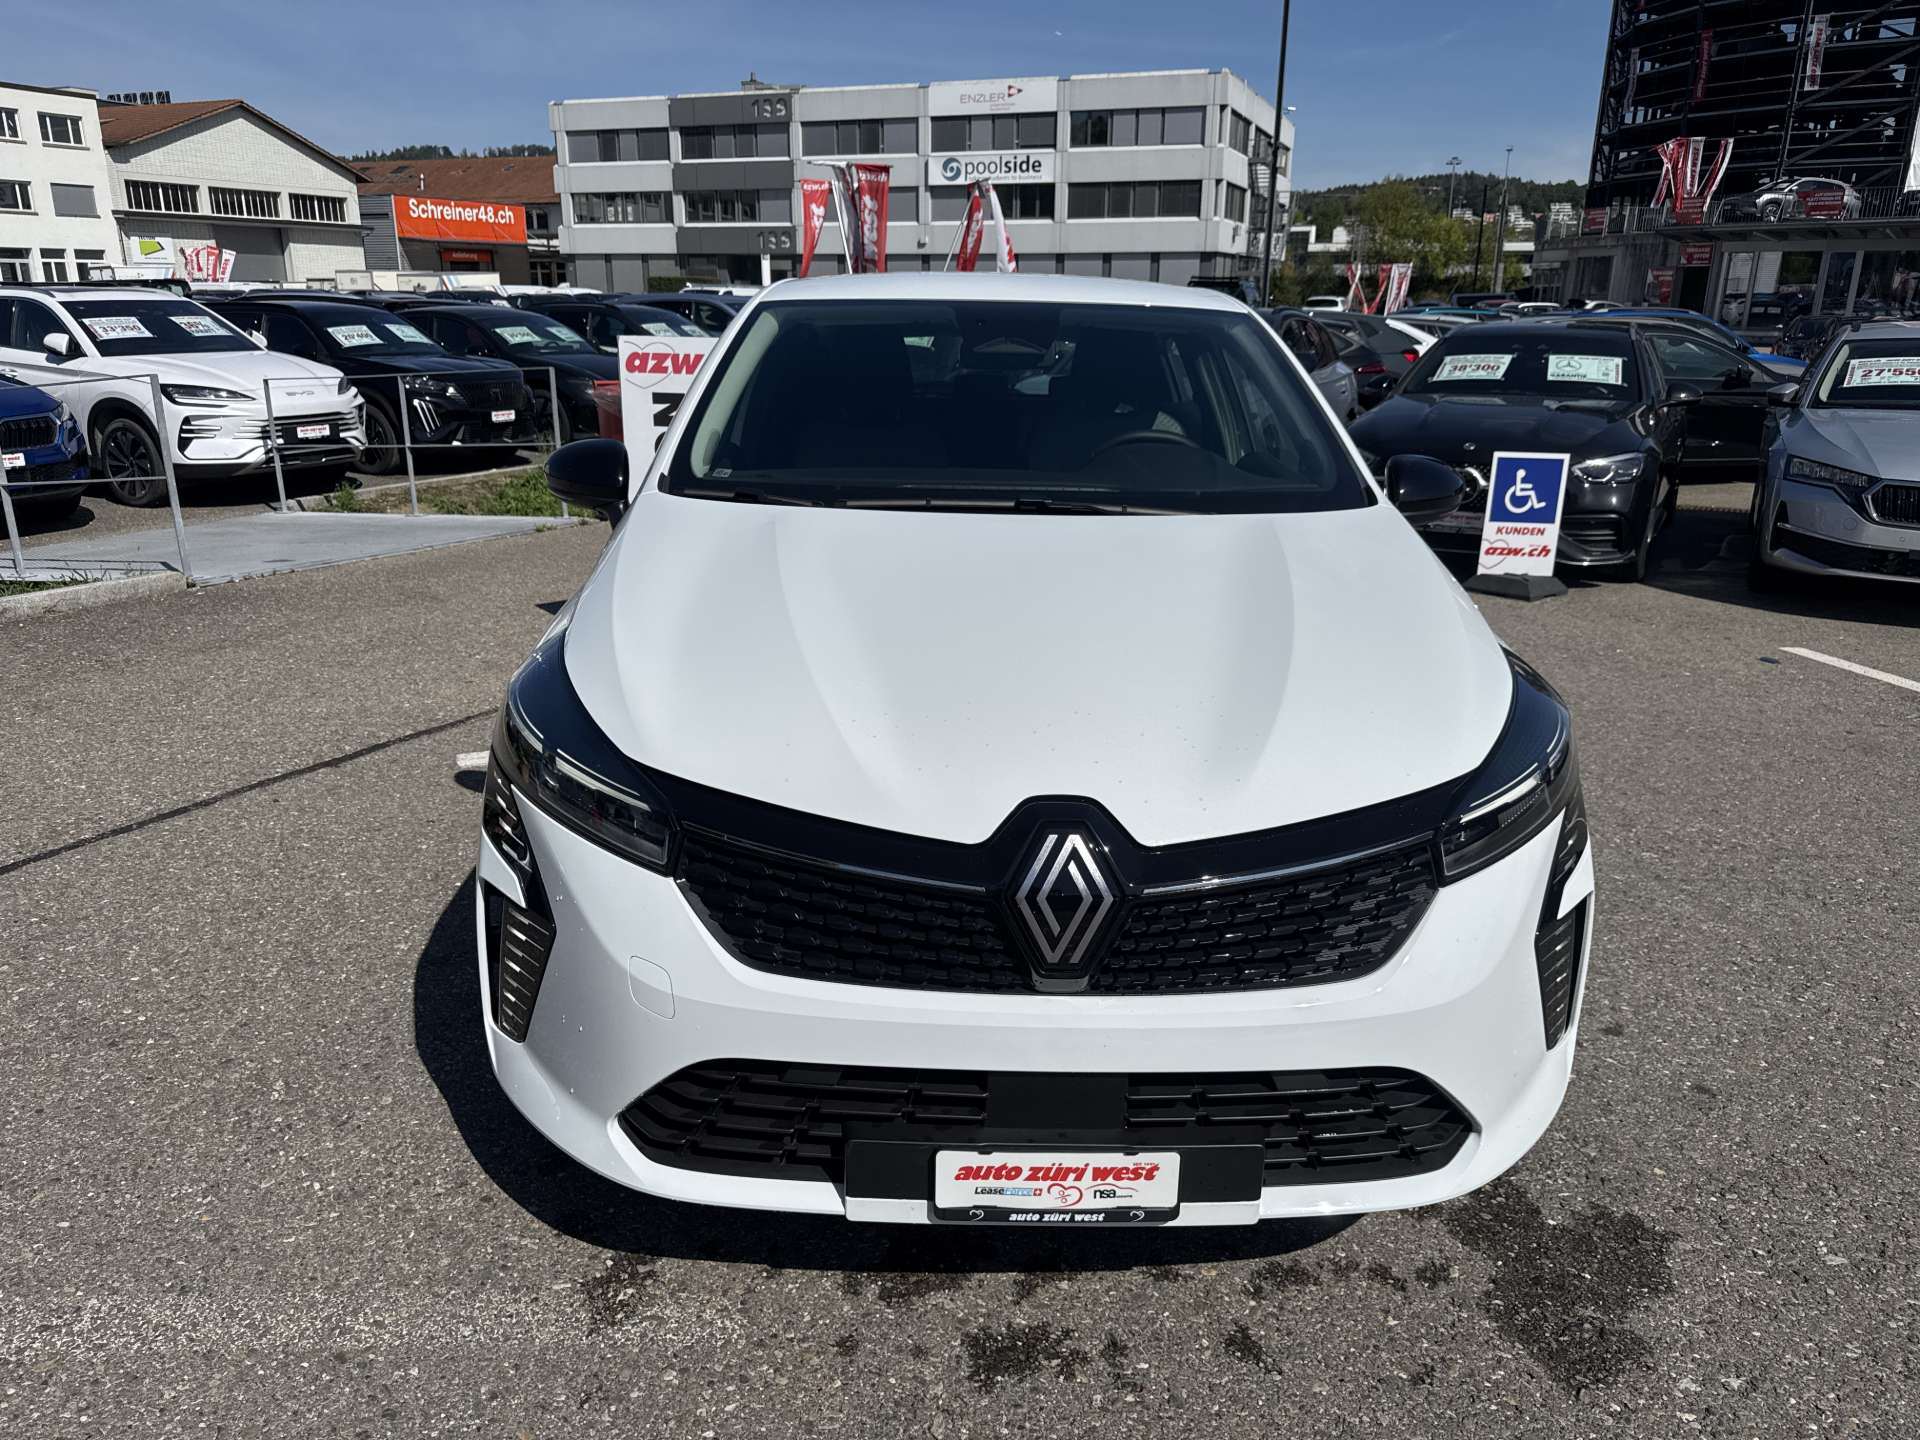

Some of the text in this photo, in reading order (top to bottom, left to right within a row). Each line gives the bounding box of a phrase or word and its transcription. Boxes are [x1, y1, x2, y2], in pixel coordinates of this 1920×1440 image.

[960, 93, 1006, 104] ENZLER
[964, 154, 1042, 181] poolside
[408, 198, 515, 225] Schreiner48.ch
[625, 351, 704, 375] azw
[1496, 527, 1546, 536] KUNDEN
[1484, 545, 1552, 558] azw.ch
[954, 1162, 1160, 1182] auto züri west
[1093, 1189, 1117, 1199] nsa
[1009, 1212, 1105, 1221] auto züri west
